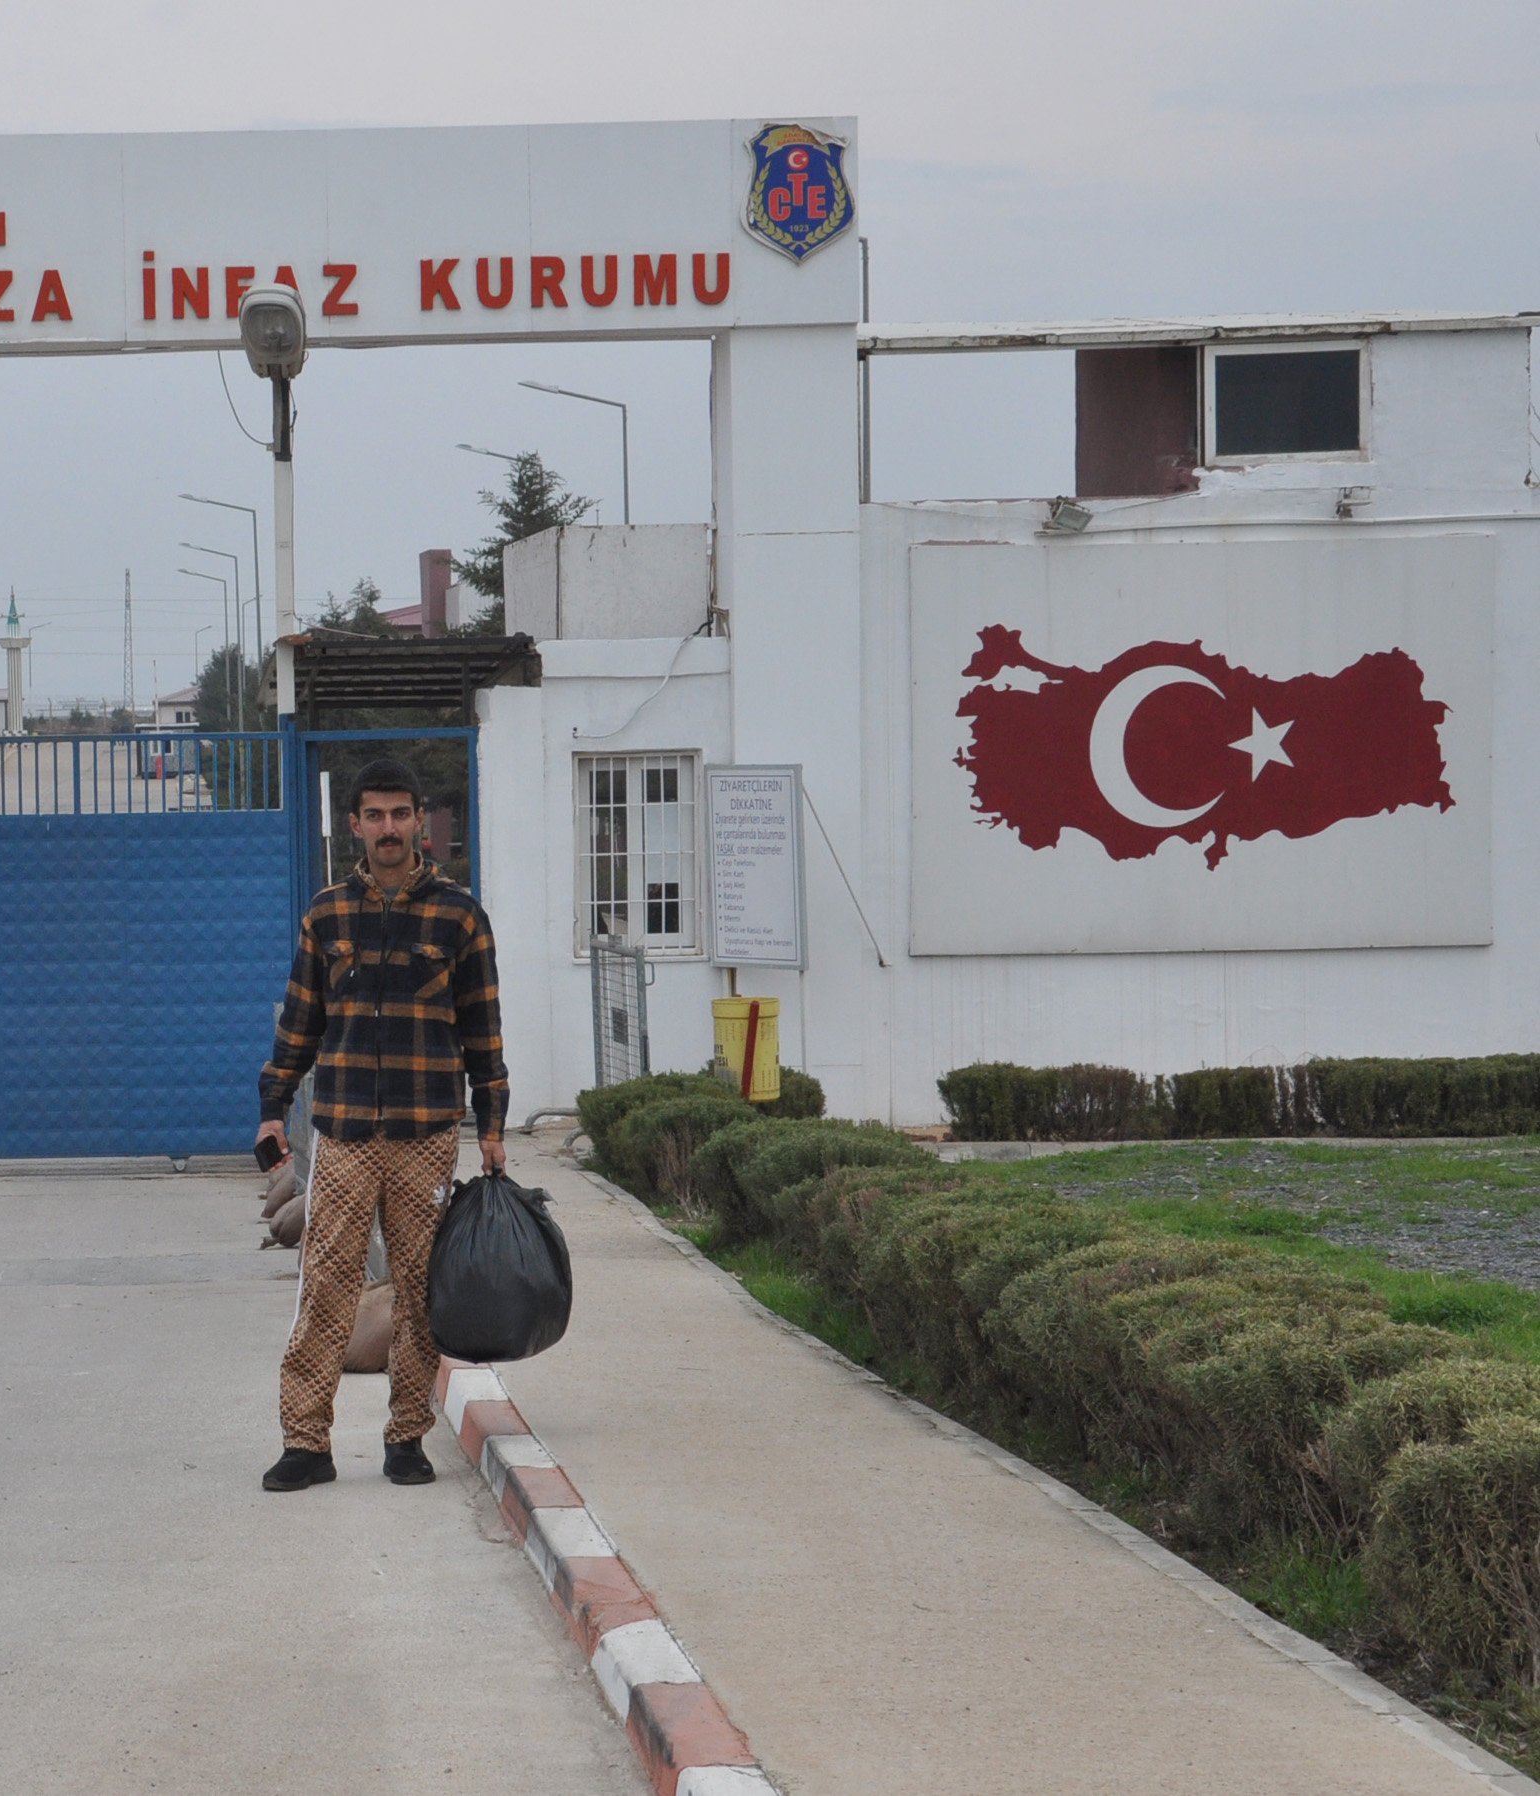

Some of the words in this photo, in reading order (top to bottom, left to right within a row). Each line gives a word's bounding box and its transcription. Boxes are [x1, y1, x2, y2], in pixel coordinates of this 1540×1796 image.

[789, 224, 810, 233] 1923
[420, 251, 732, 312] KURUMU
[720, 779, 783, 794] ZİYARETÇİLERİN
[730, 797, 773, 811] DİKKATİNE
